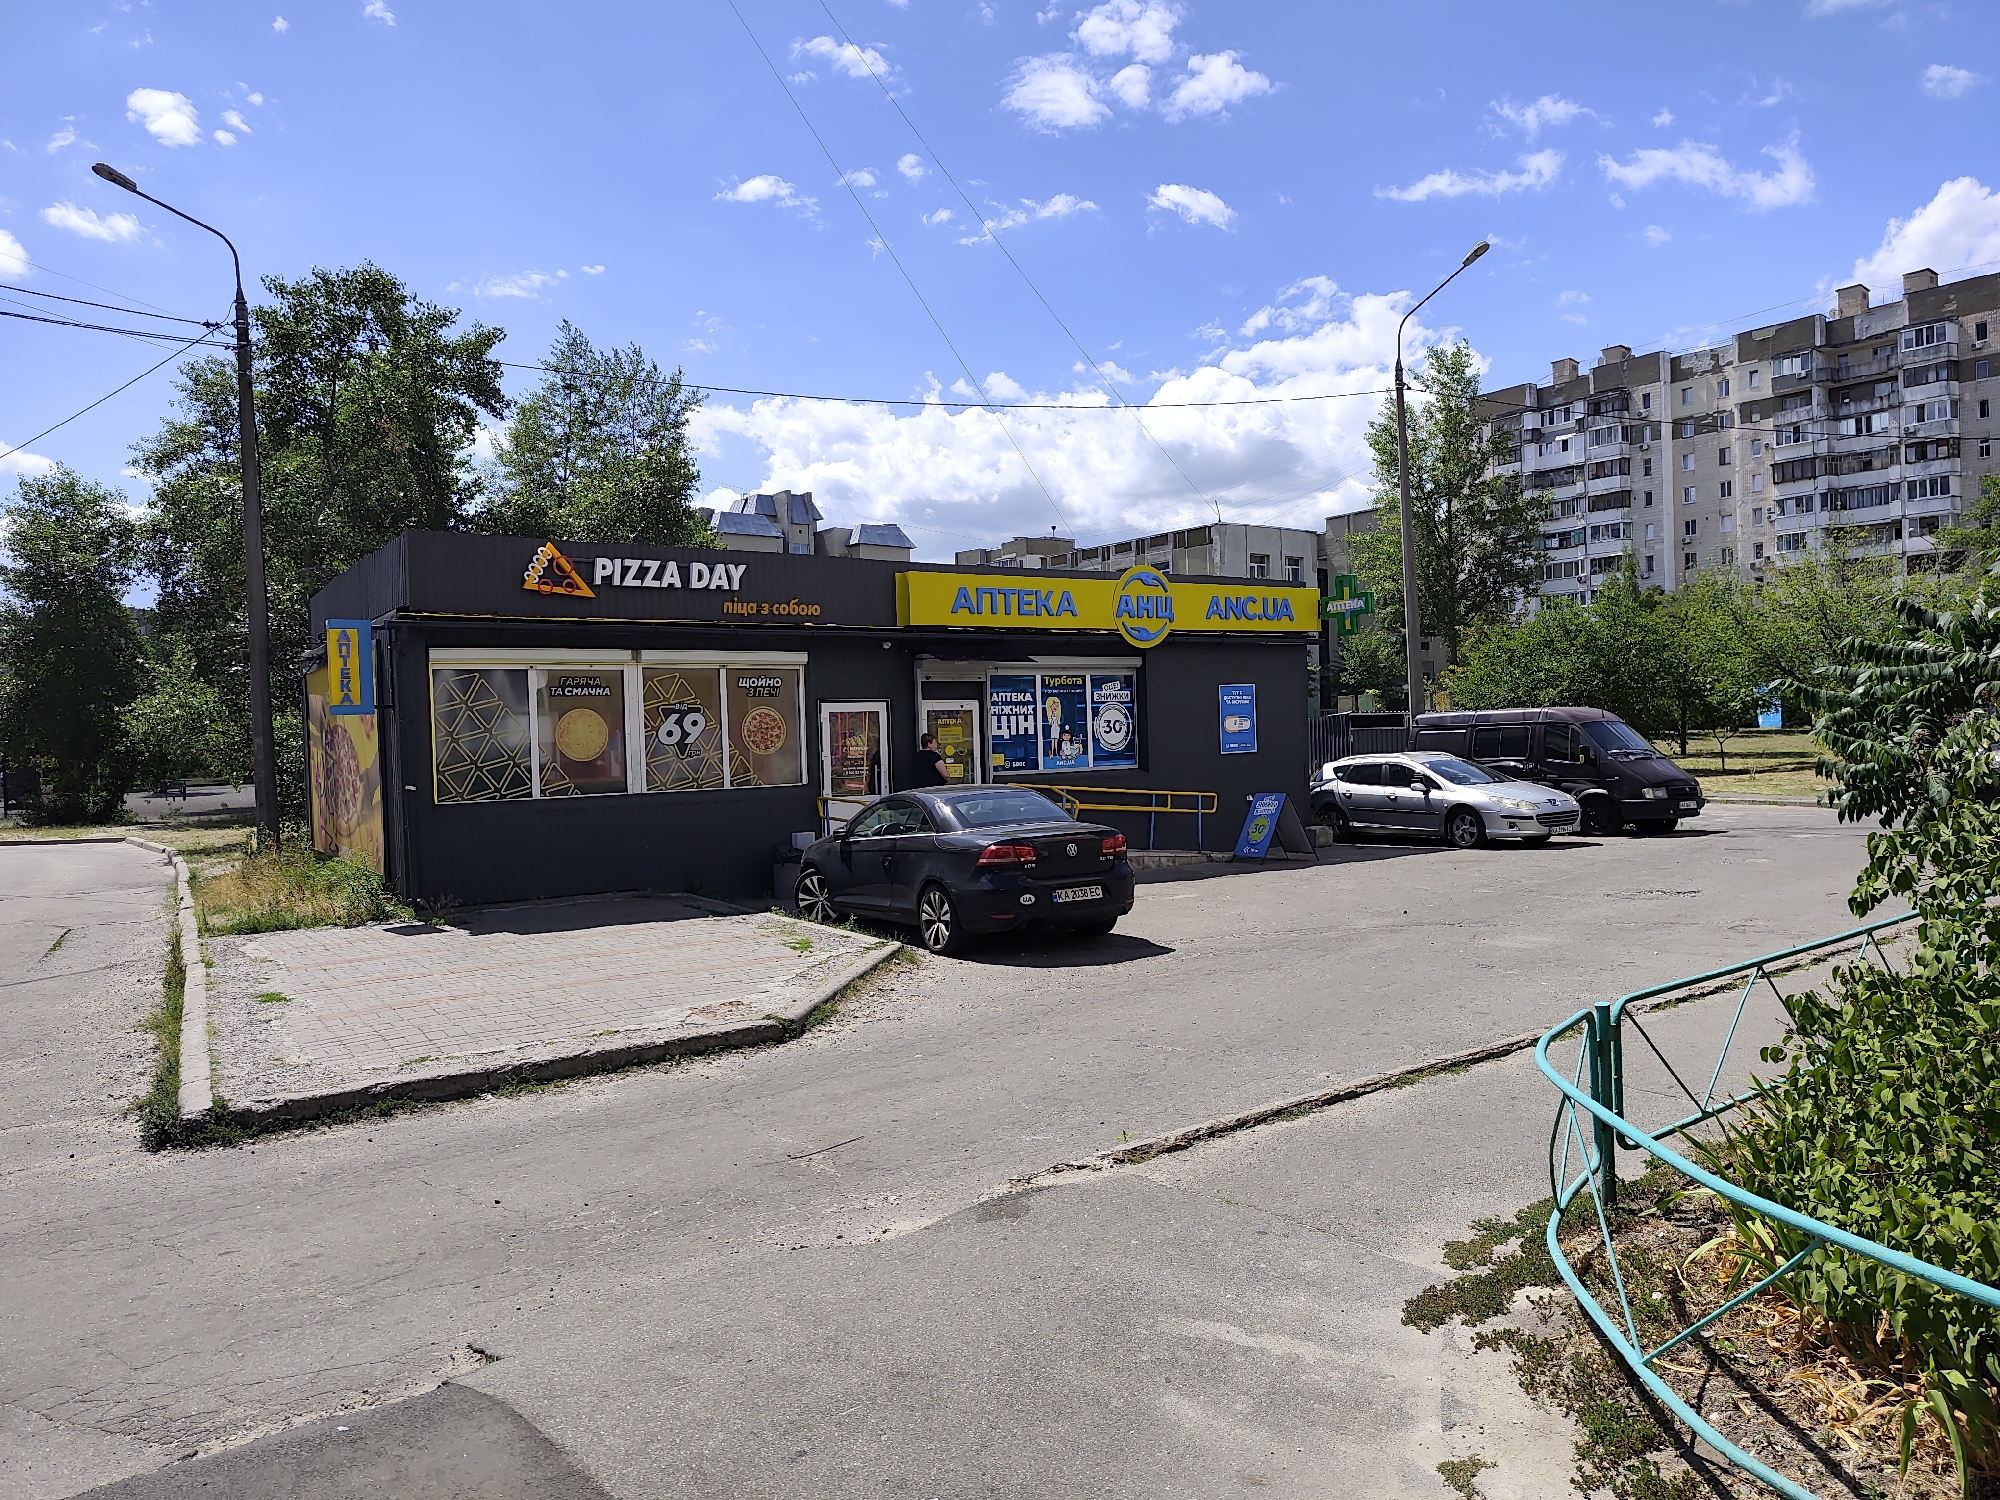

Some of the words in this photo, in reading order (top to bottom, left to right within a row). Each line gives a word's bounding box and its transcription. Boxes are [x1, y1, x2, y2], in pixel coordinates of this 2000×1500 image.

[594, 557, 682, 590] PIZZA
[689, 562, 747, 592] DAY
[723, 598, 757, 617] піца
[760, 604, 770, 615] з
[773, 599, 821, 617] собою
[951, 586, 1079, 618] АПТЕКА
[1116, 593, 1175, 624] АНЦ
[1205, 594, 1295, 622] ANC.UA
[1327, 599, 1366, 612] АПТЕКА
[337, 629, 354, 705] АПТЕКА
[560, 677, 601, 687] ГАРЯЧА
[738, 676, 782, 688] ЩОЙНО
[1044, 676, 1082, 687] Турбота
[550, 687, 563, 696] ТА
[565, 687, 611, 696] СМАЧНА
[755, 688, 780, 697] ПЕЧІ
[991, 692, 1034, 702] АПТЕКА
[1095, 692, 1130, 701] ЗНИЖКИ
[675, 702, 688, 711] від
[658, 713, 706, 745] 69
[991, 715, 1035, 739] ЦІН
[1057, 890, 1070, 901] KA
[1071, 888, 1089, 900] 2038
[1089, 887, 1101, 897] EC
